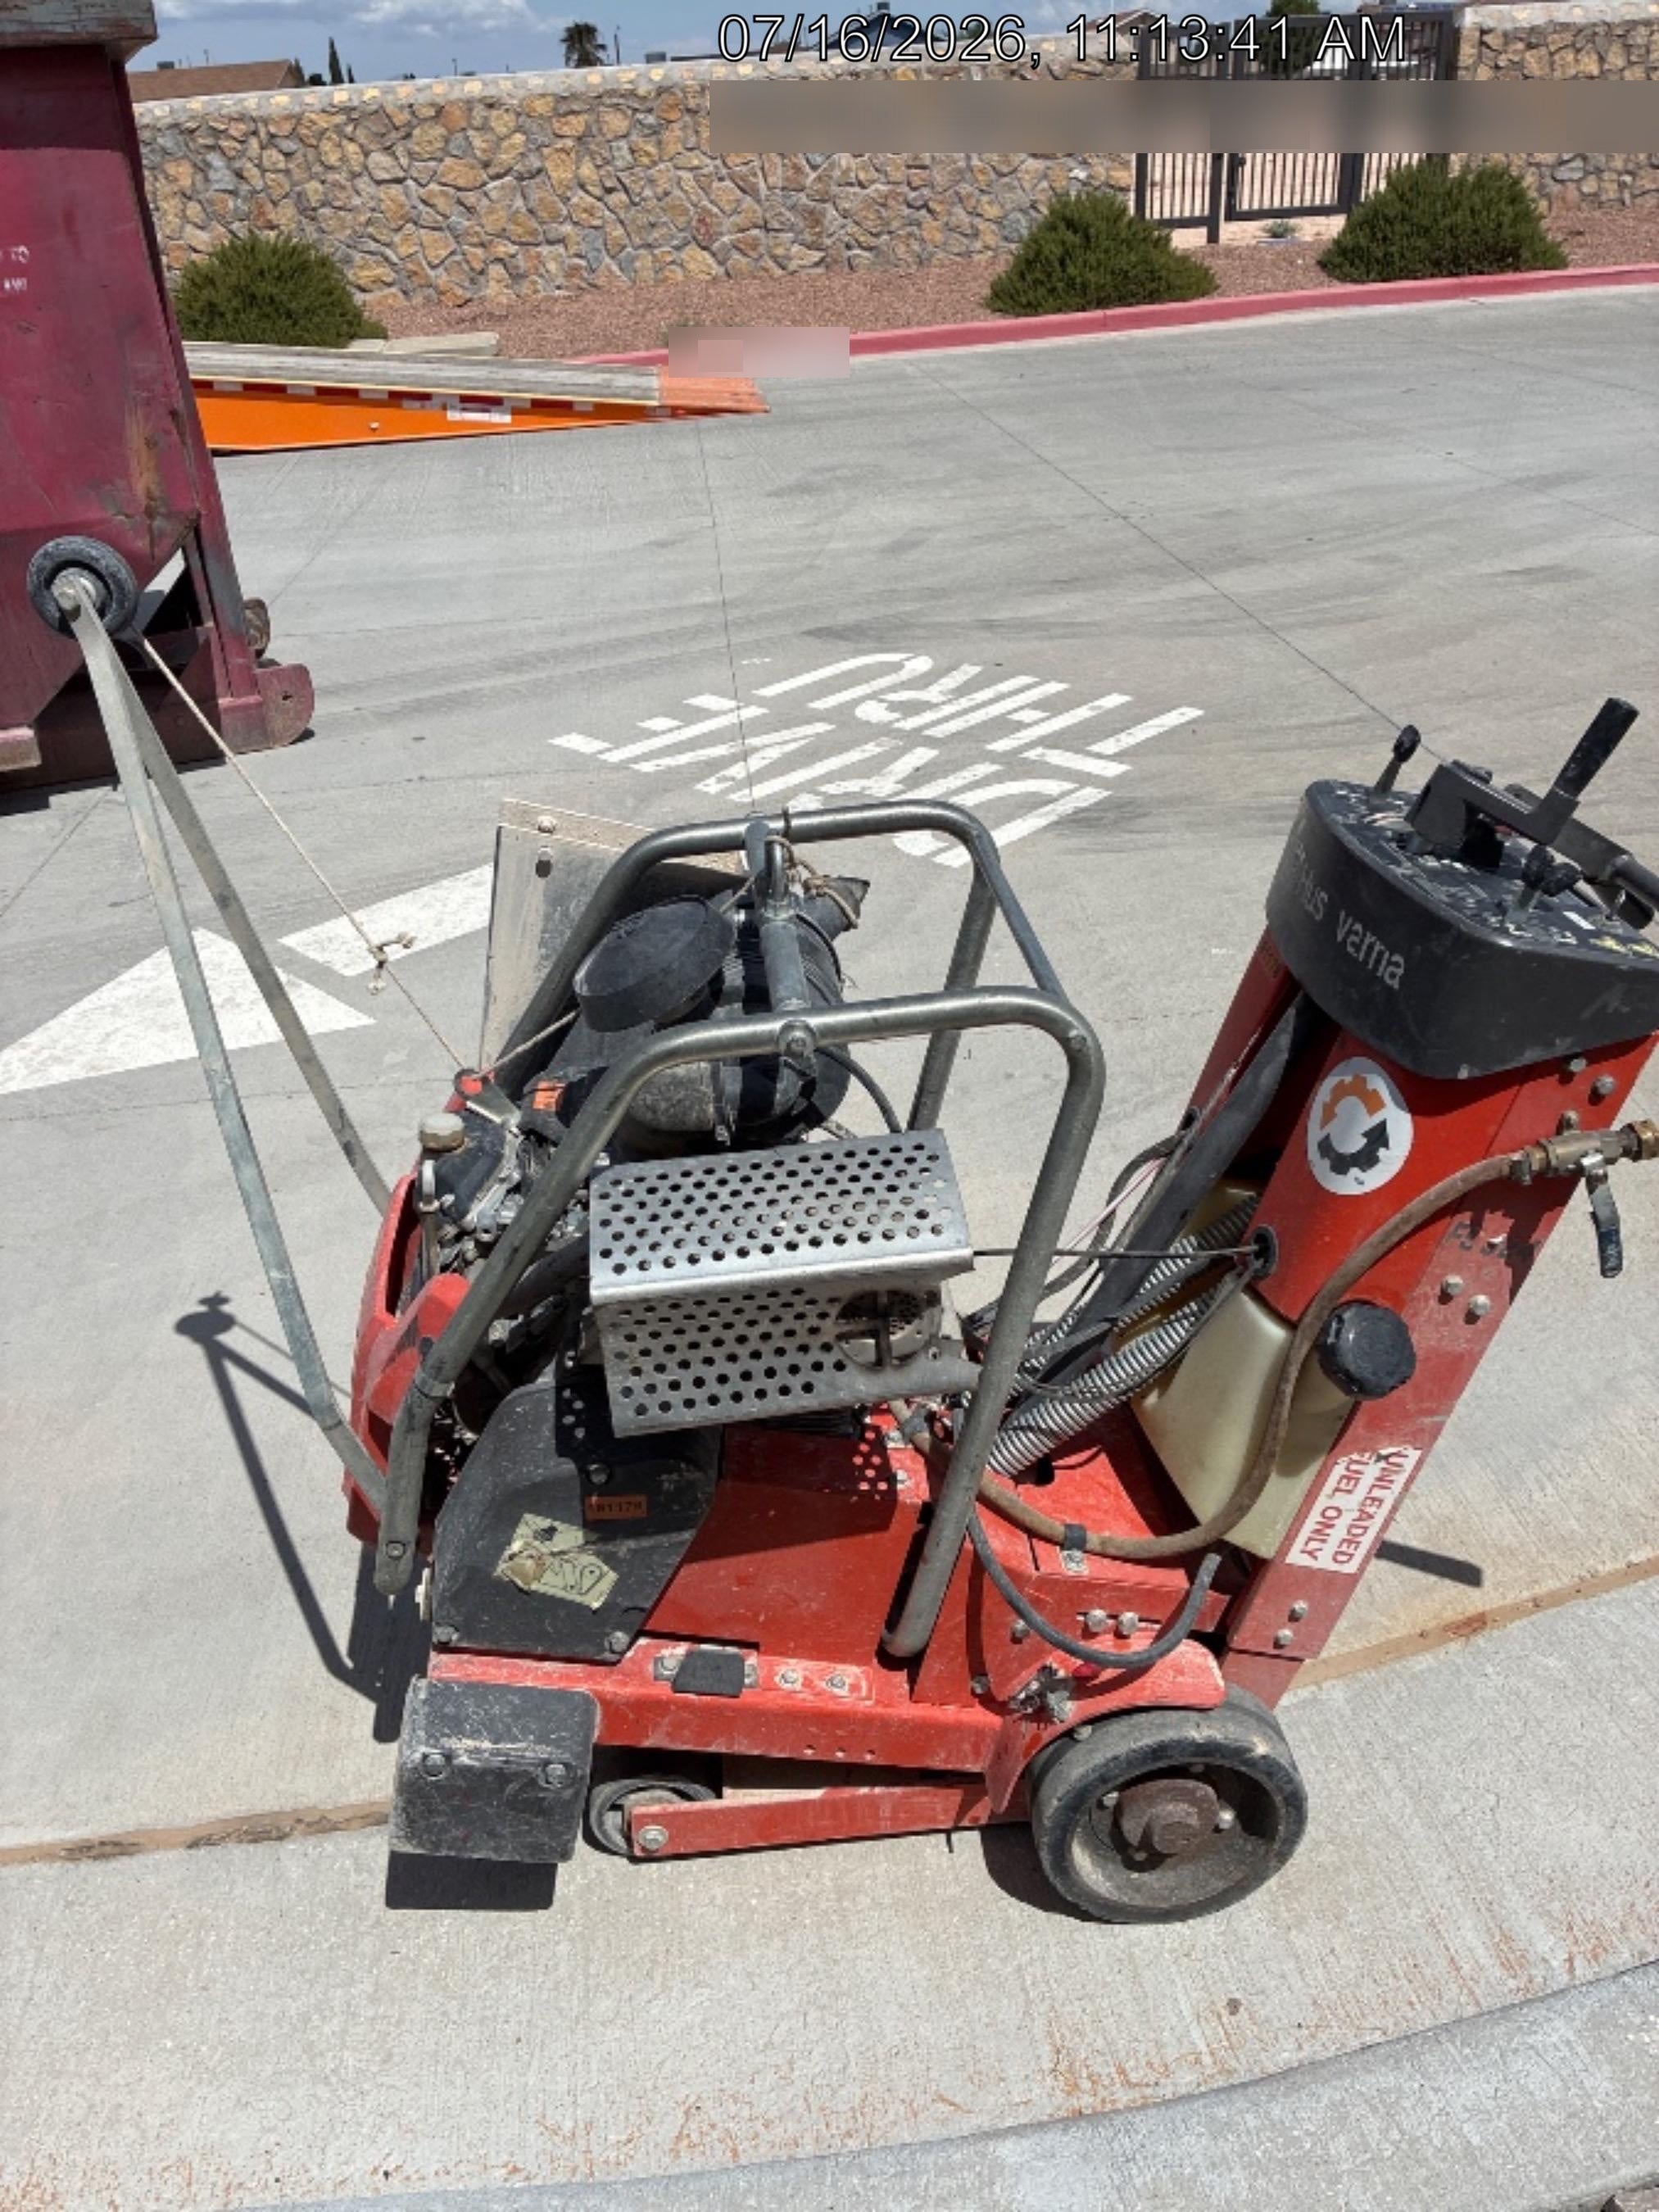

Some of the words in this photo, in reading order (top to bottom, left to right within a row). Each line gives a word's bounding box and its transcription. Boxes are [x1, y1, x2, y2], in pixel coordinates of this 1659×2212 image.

[752, 653, 1204, 777] THRU
[548, 693, 1112, 868] DRIVE
[1300, 1506, 1343, 1561] ONLY
[1331, 1451, 1409, 1564] UNLEADED
